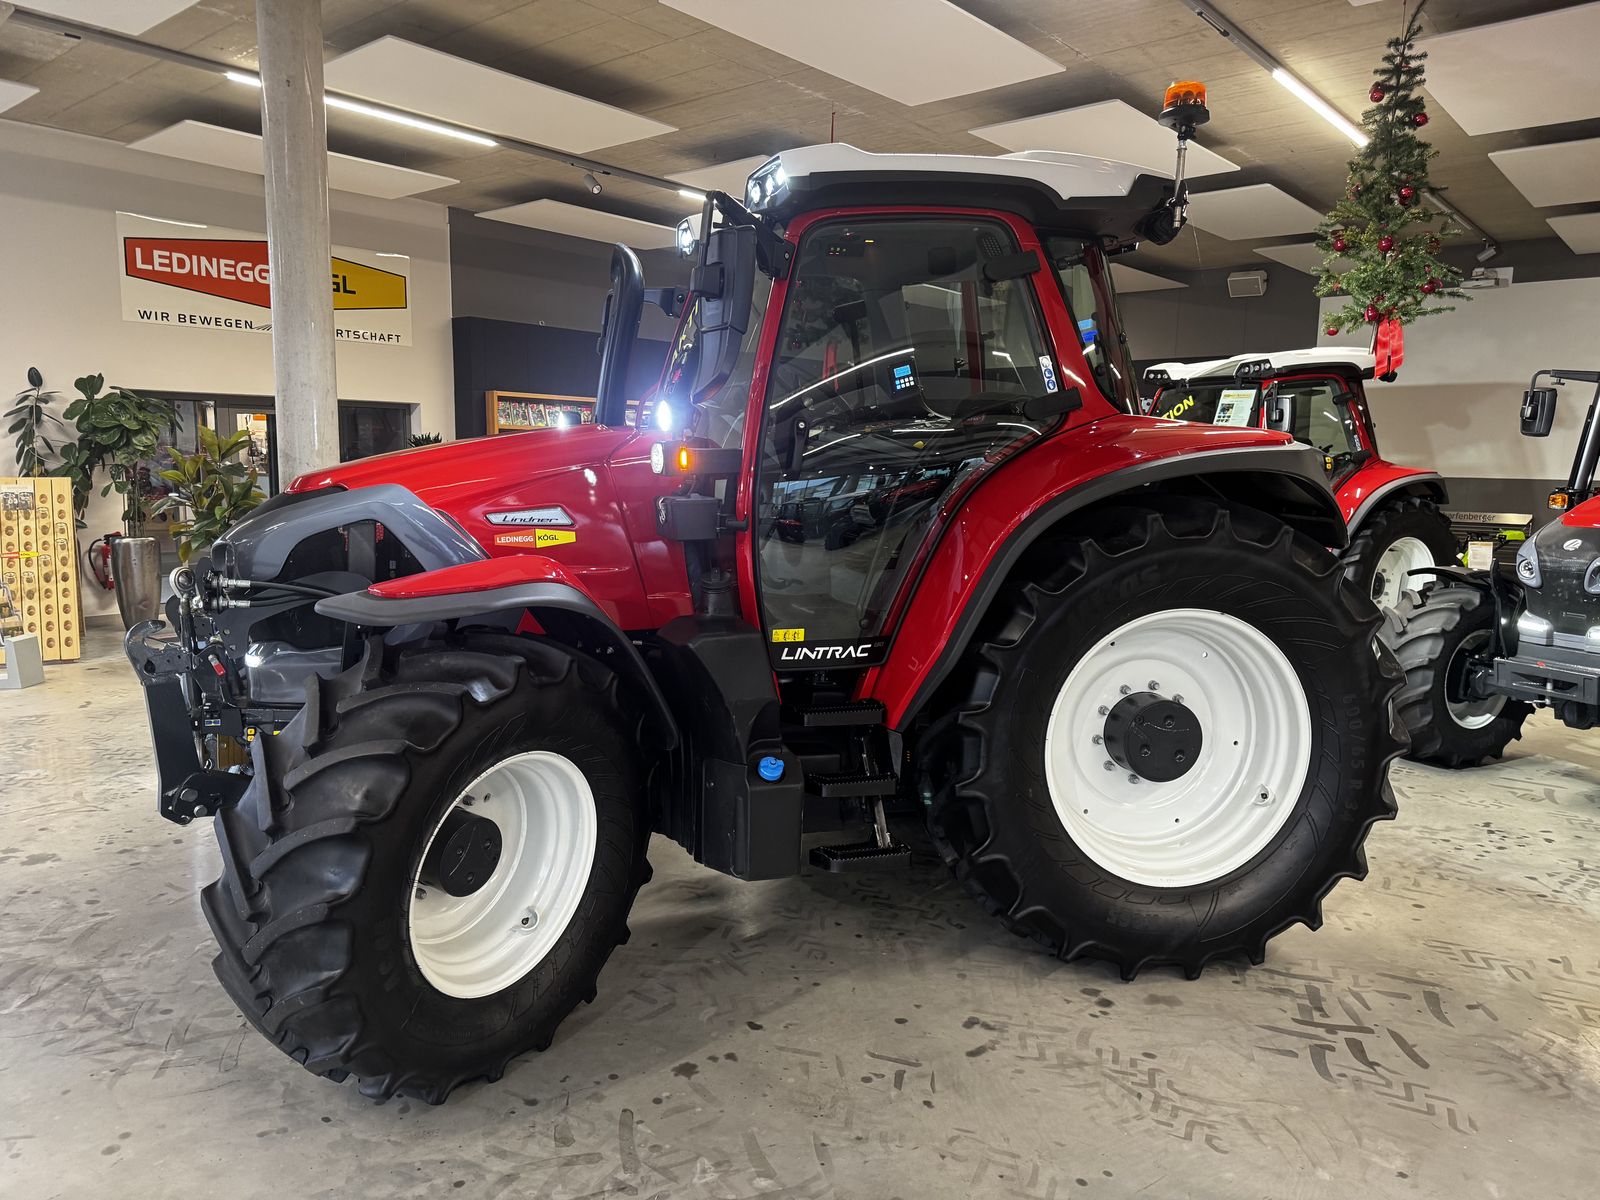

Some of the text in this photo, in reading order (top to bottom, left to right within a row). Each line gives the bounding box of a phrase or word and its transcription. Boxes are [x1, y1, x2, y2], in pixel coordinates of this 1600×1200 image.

[135, 247, 357, 295] LEDINEGG GL
[138, 309, 401, 343] WIR BEWEGEN RTSCHAFT
[1161, 395, 1195, 419] TION
[503, 515, 558, 523] Lindner
[1444, 512, 1495, 523] rfenberger
[496, 535, 534, 543] LEDINEGG
[781, 644, 872, 660] LINTRAC
